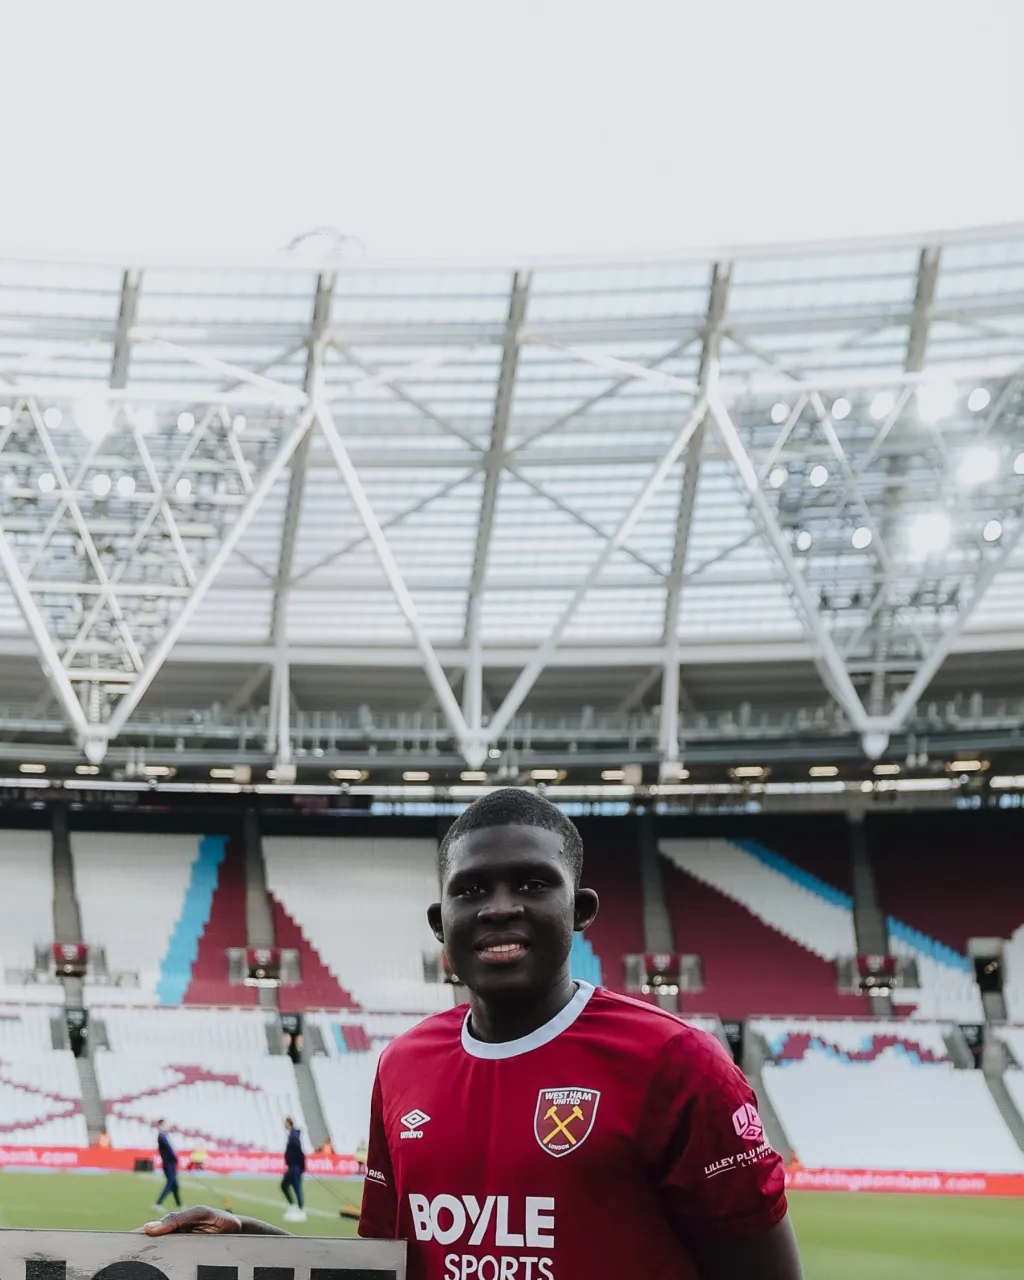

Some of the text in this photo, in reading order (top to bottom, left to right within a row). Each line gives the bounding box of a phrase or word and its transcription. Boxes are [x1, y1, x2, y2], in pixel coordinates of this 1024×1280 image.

[545, 1091, 592, 1102] WEST HAM
[400, 1129, 424, 1139] umbro
[548, 1142, 570, 1151] LONDON
[704, 1155, 735, 1175] LILLEY
[409, 1193, 555, 1249] BOYLE
